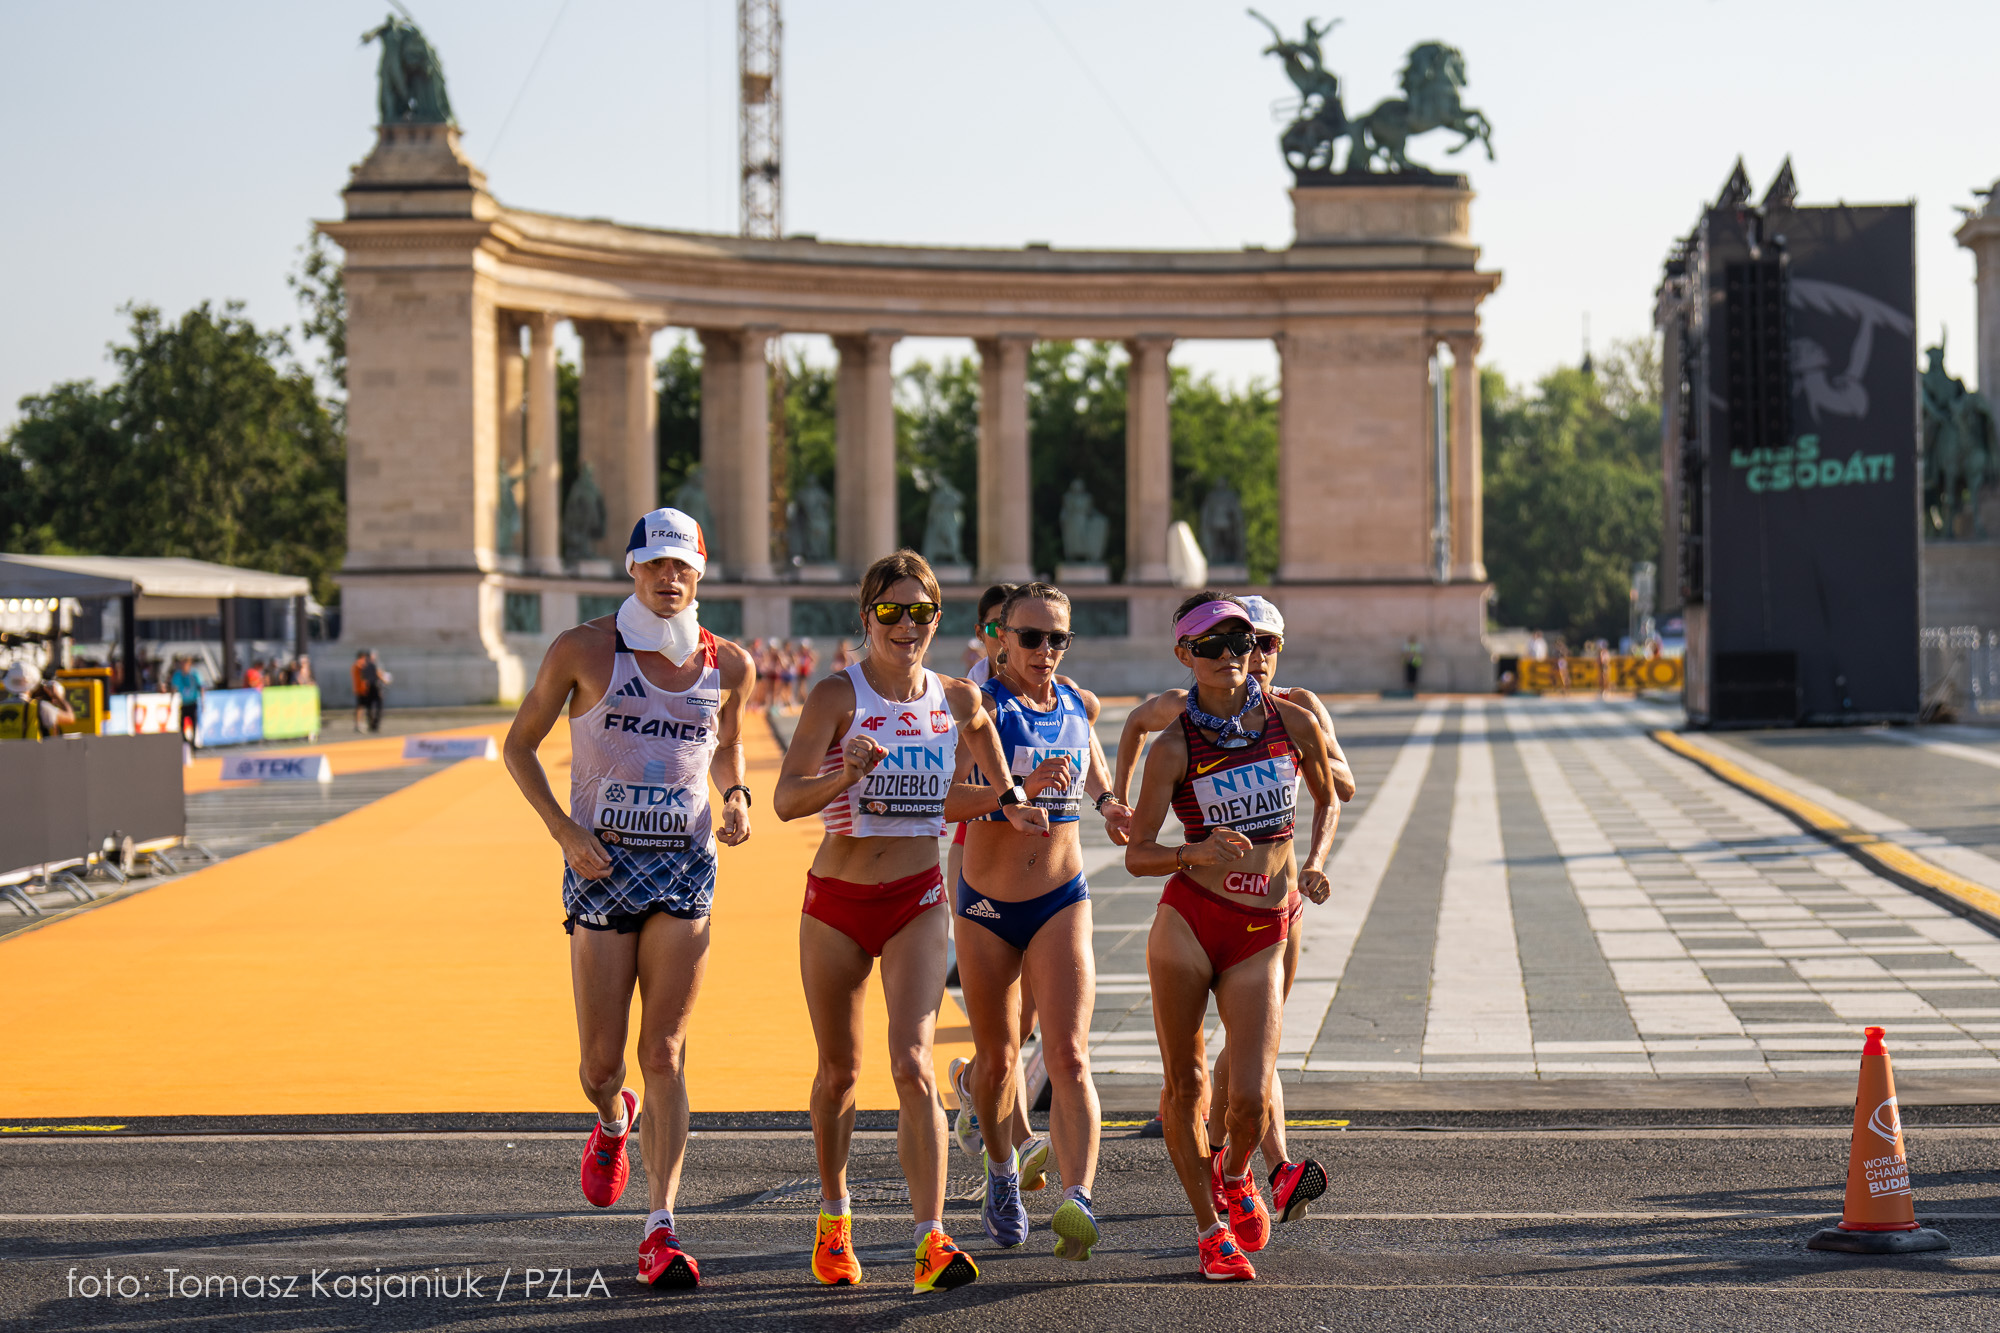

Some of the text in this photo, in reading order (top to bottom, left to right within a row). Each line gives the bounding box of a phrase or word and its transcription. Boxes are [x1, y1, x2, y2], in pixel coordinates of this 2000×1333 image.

[1746, 450, 1894, 492] CSODÁT!
[604, 713, 707, 743] FRANCE
[861, 716, 887, 731] 4F
[254, 758, 305, 776] TDK
[883, 746, 944, 771] NTN
[863, 775, 939, 797] ZDZIEBŁO
[1211, 760, 1279, 797] NTN
[626, 785, 688, 808] TDK
[1208, 785, 1292, 824] QIEYANG
[600, 807, 688, 833] QUINION
[1225, 872, 1269, 895] CHN
[966, 907, 1001, 919] adidas
[1863, 1154, 1900, 1169] WORLD
